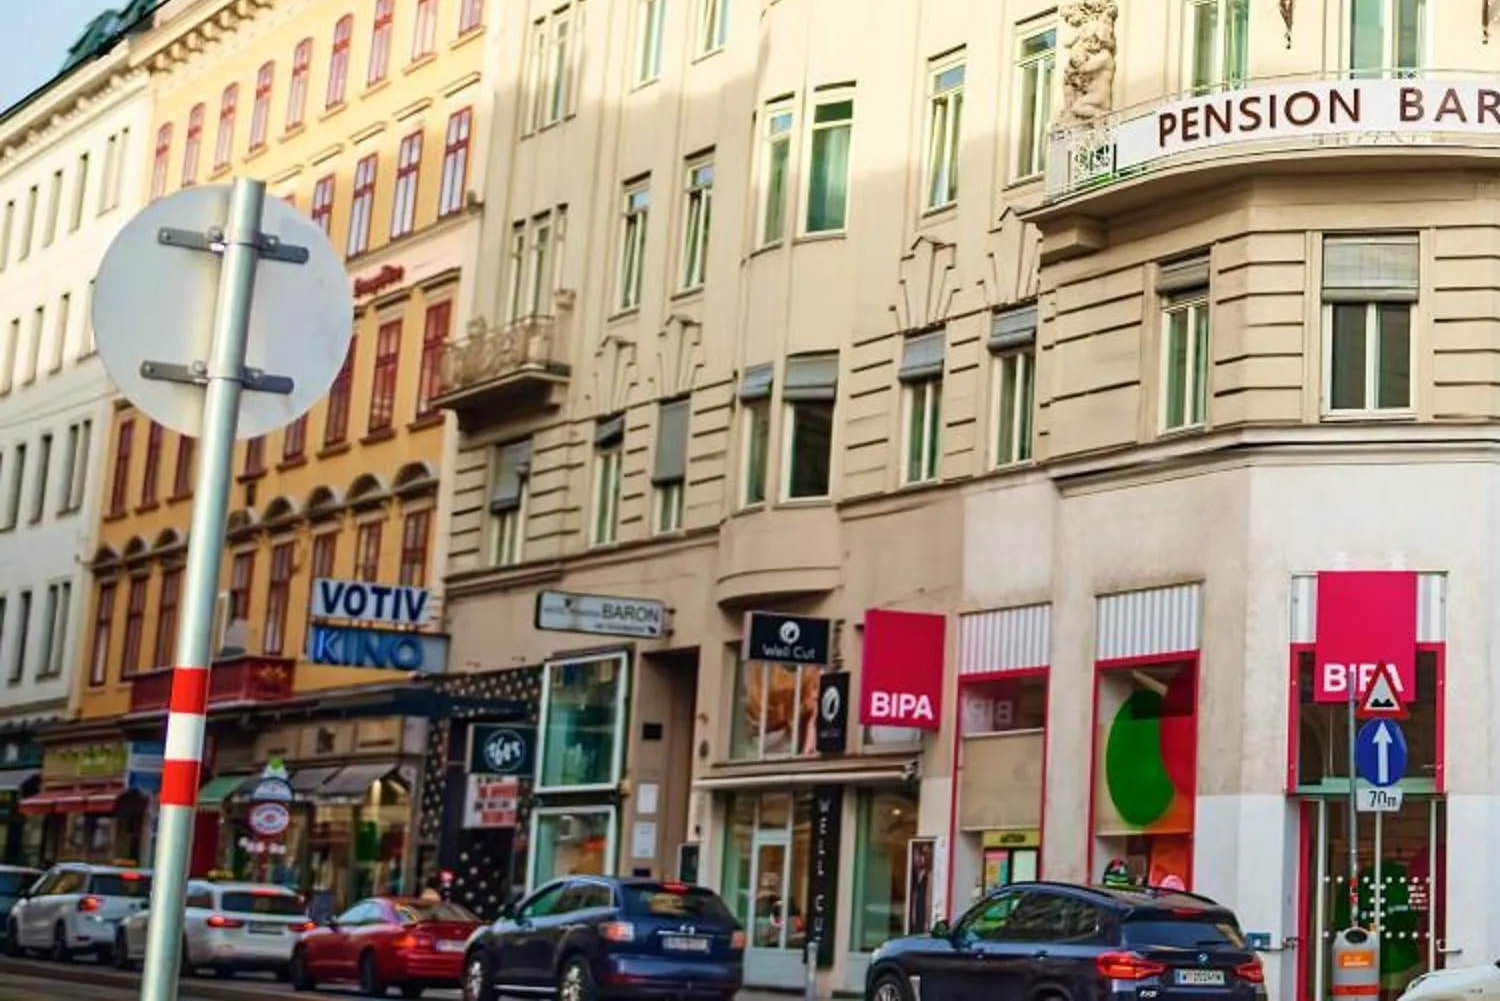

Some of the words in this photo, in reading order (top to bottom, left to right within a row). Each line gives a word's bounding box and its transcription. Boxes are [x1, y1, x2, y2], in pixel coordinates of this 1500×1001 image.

[1158, 88, 1362, 147] PENSION
[321, 581, 428, 621] VOTIV
[602, 603, 659, 622] BARON
[312, 627, 423, 670] KINO
[762, 643, 790, 658] Well
[793, 645, 815, 659] Cut
[870, 691, 934, 719] BIPA
